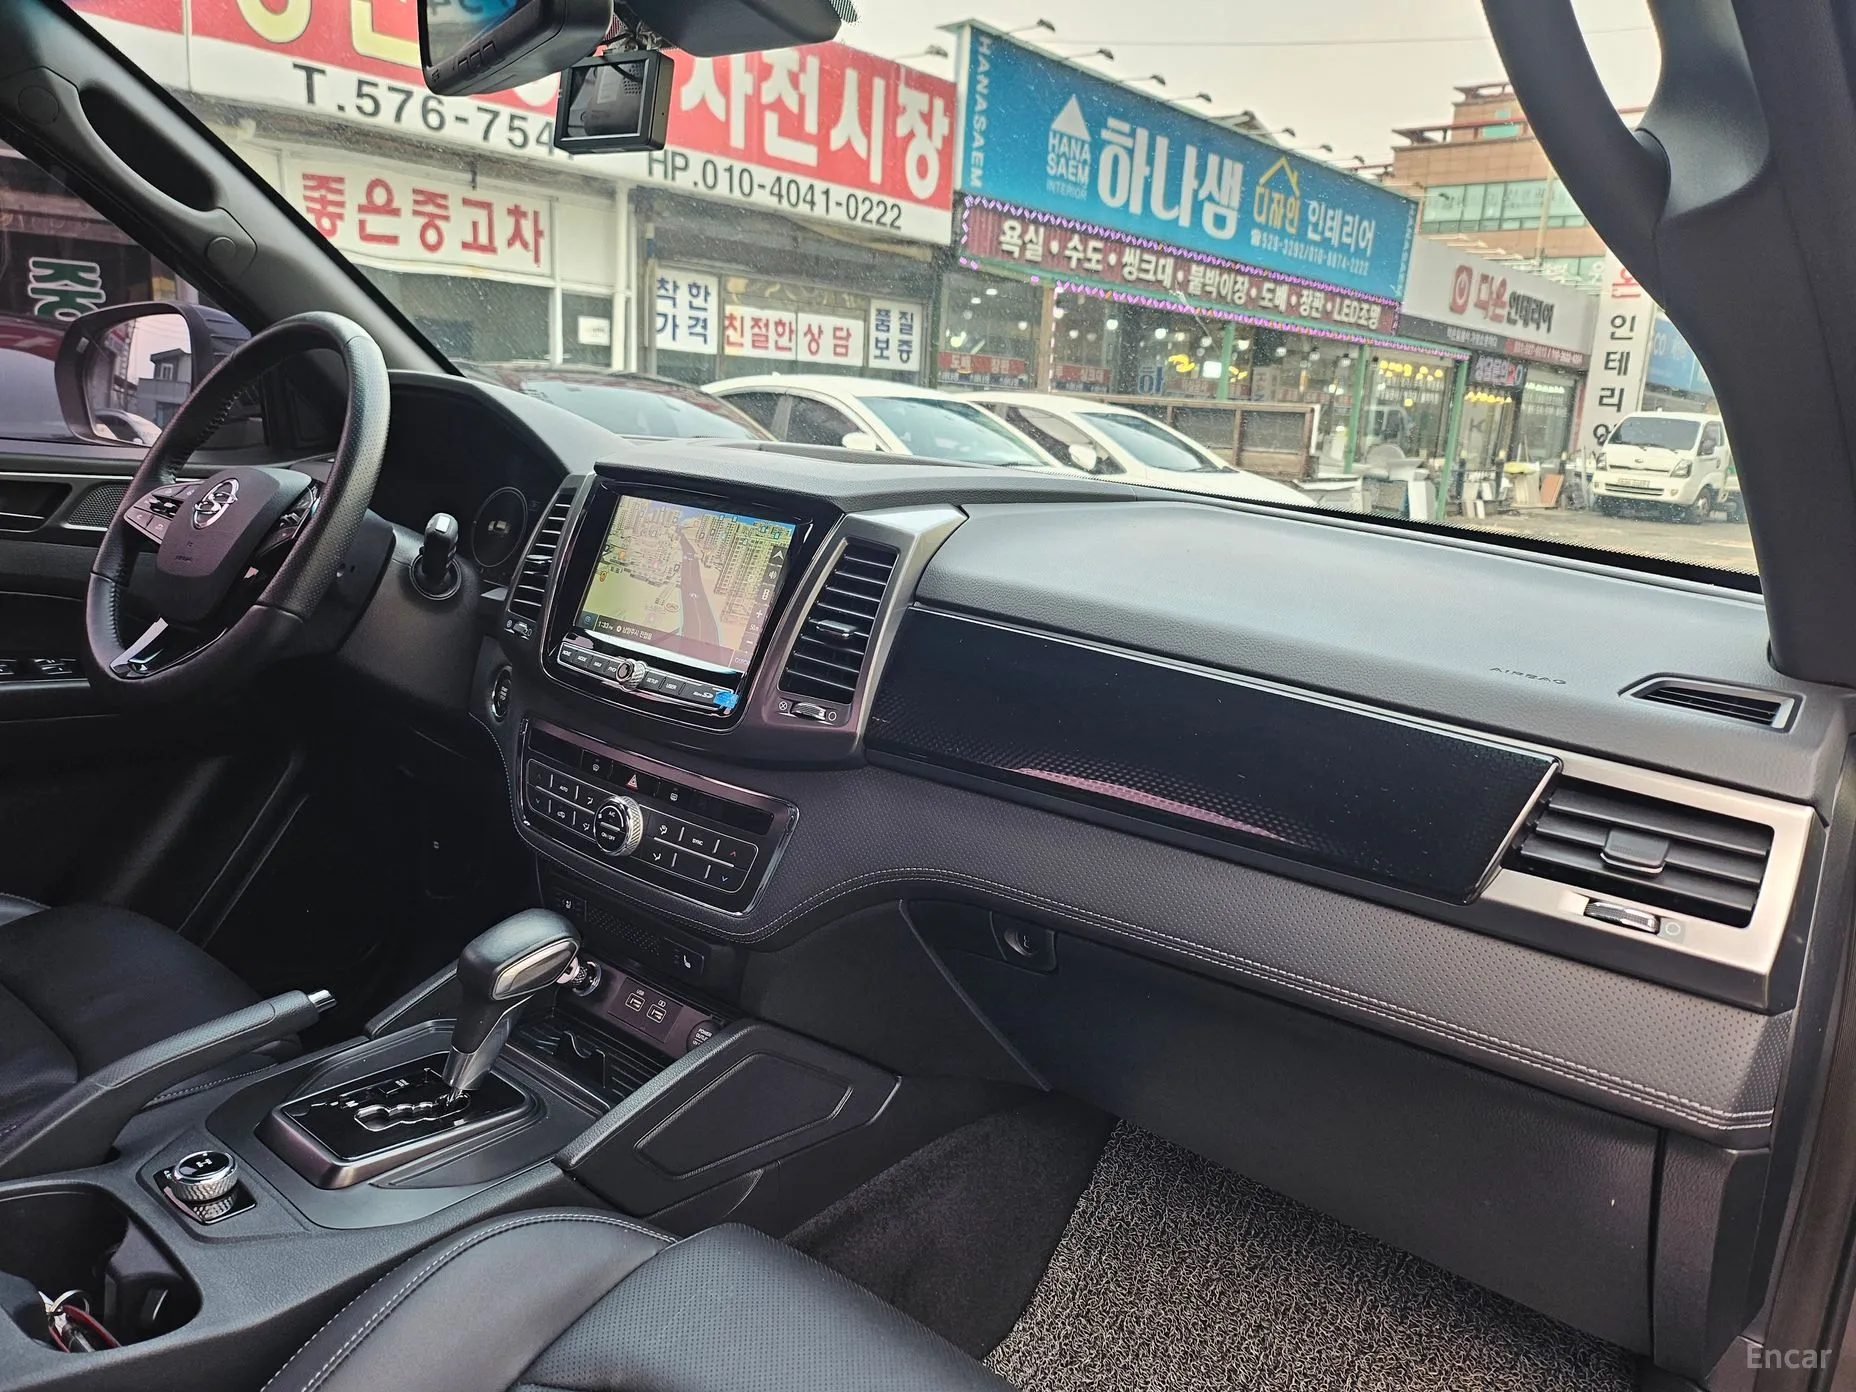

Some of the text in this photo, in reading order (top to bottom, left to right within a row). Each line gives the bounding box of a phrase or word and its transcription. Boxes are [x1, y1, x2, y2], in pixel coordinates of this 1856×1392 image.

[291, 61, 576, 161] T.576-754
[969, 36, 991, 188] HANASAEM
[1046, 151, 1090, 185] SAEM
[1047, 130, 1091, 164] HANA
[1046, 180, 1088, 200] INTERIOR
[1098, 116, 1244, 241] 하나샘
[301, 172, 547, 266] 좋은중고차
[1252, 185, 1376, 257] 디자인 인테리어
[656, 276, 712, 314] 착한
[1000, 219, 1044, 260] 욕실
[1065, 239, 1104, 273] 수도
[1122, 248, 1174, 291] 씽크대
[1258, 281, 1290, 313] 도배
[1300, 288, 1325, 318] 장판
[1333, 297, 1382, 330] LED조명
[656, 312, 710, 345] 가격
[875, 307, 914, 334] 품질
[1506, 290, 1556, 334] 인테리어
[723, 312, 852, 358] 친절한 상담
[874, 337, 914, 364] 보증
